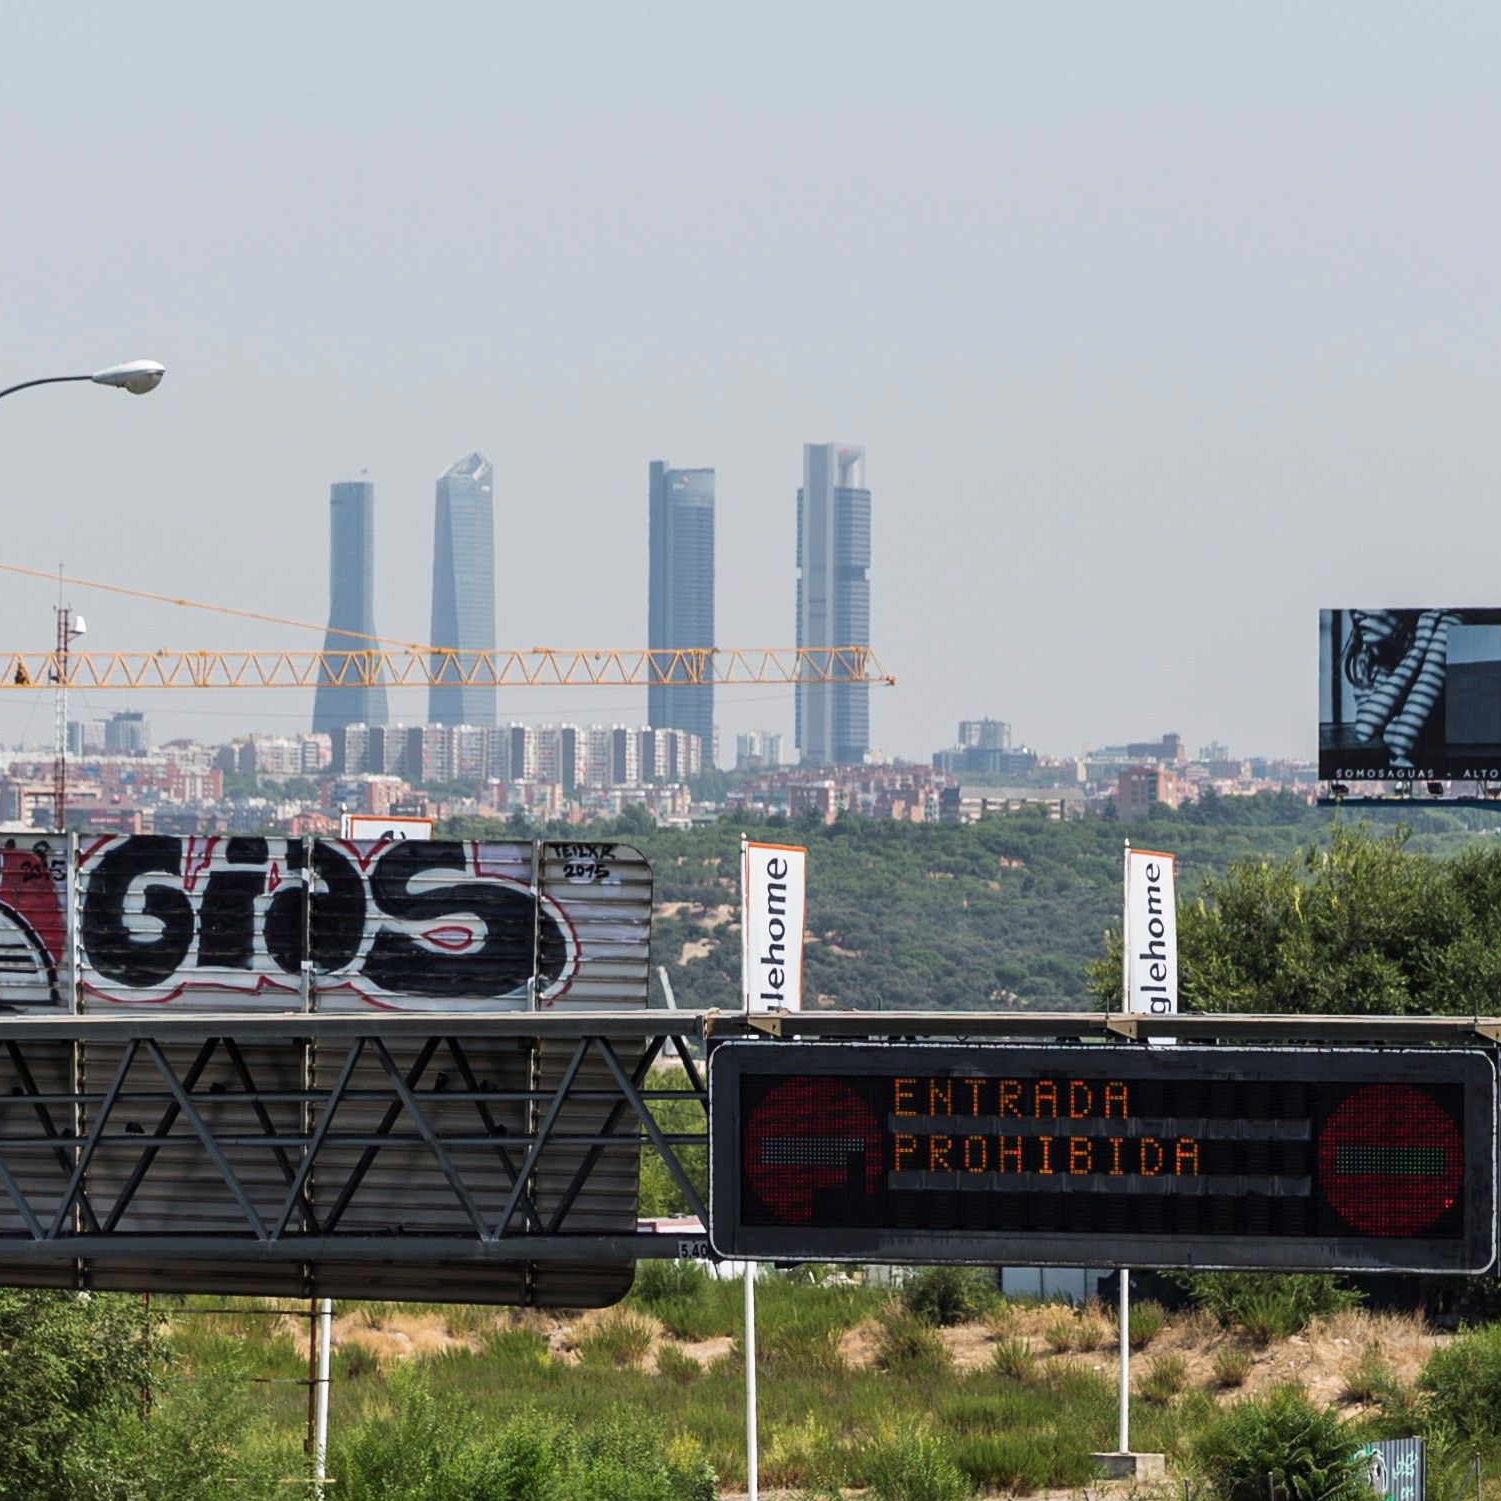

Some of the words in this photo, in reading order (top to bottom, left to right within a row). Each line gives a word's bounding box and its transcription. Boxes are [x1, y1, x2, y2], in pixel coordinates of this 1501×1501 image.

[1336, 768, 1435, 779] SOMOSAGUAS
[563, 862, 610, 879] 2015
[760, 857, 788, 1010] lehome
[895, 1078, 1129, 1120] ENTRADA
[895, 1133, 1198, 1176] PROHIBIDA
